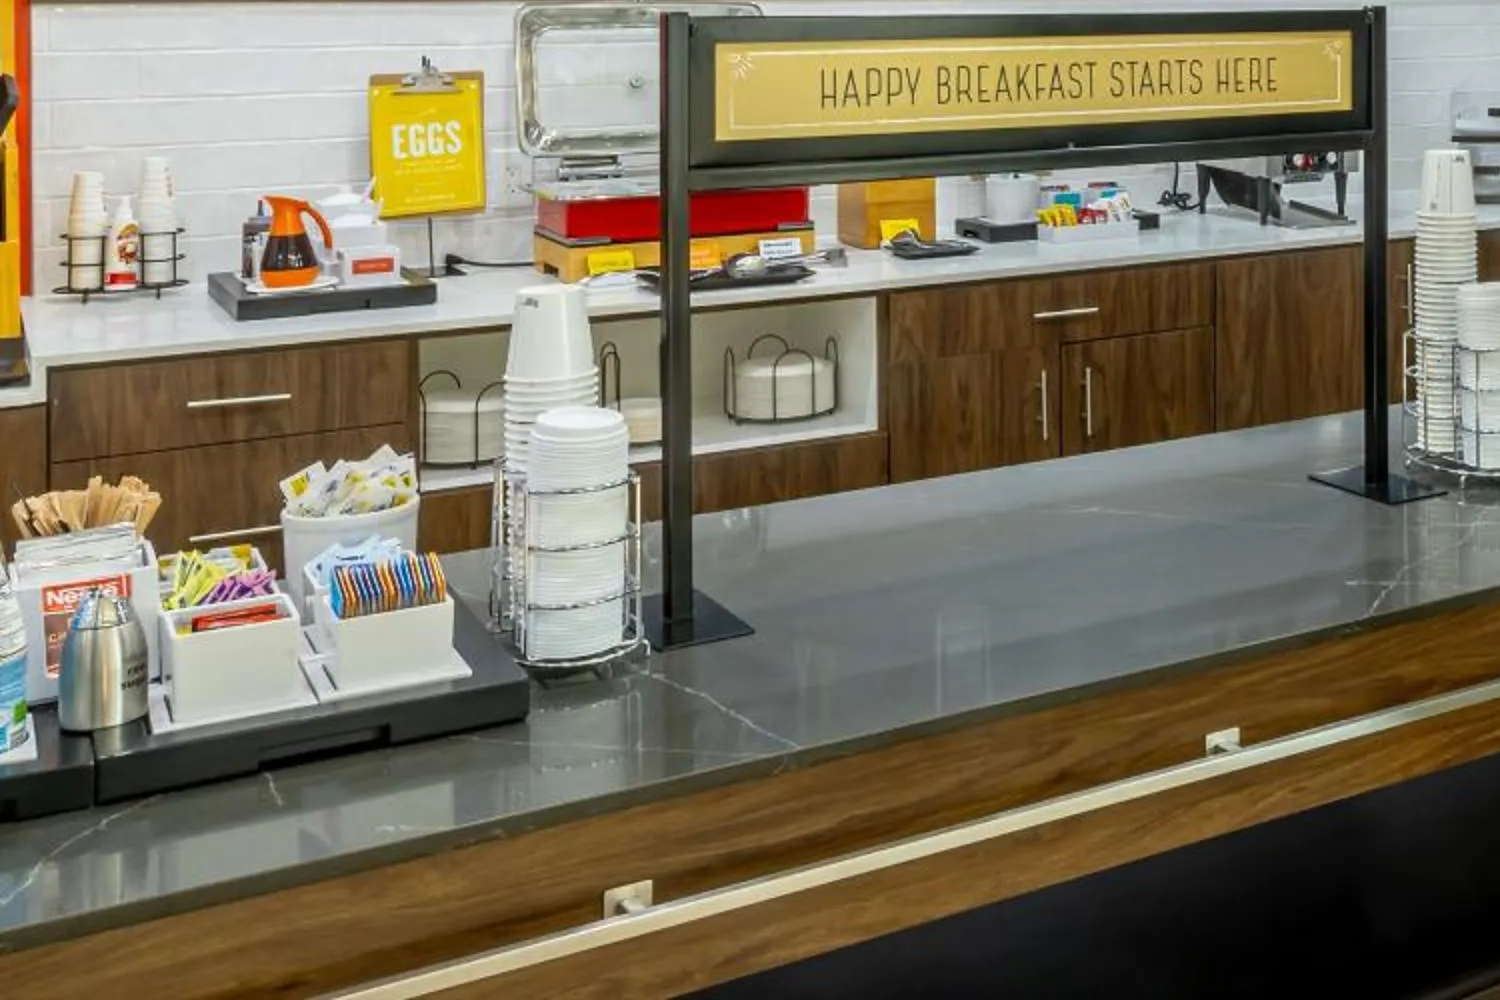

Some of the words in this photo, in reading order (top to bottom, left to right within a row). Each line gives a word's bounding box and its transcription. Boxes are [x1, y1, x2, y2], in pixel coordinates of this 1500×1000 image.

[821, 67, 921, 109] HAPPY
[937, 61, 1097, 105] BREAKFAST
[1110, 59, 1203, 98] STARTS
[1216, 57, 1278, 94] HERE
[392, 120, 463, 159] EGGS
